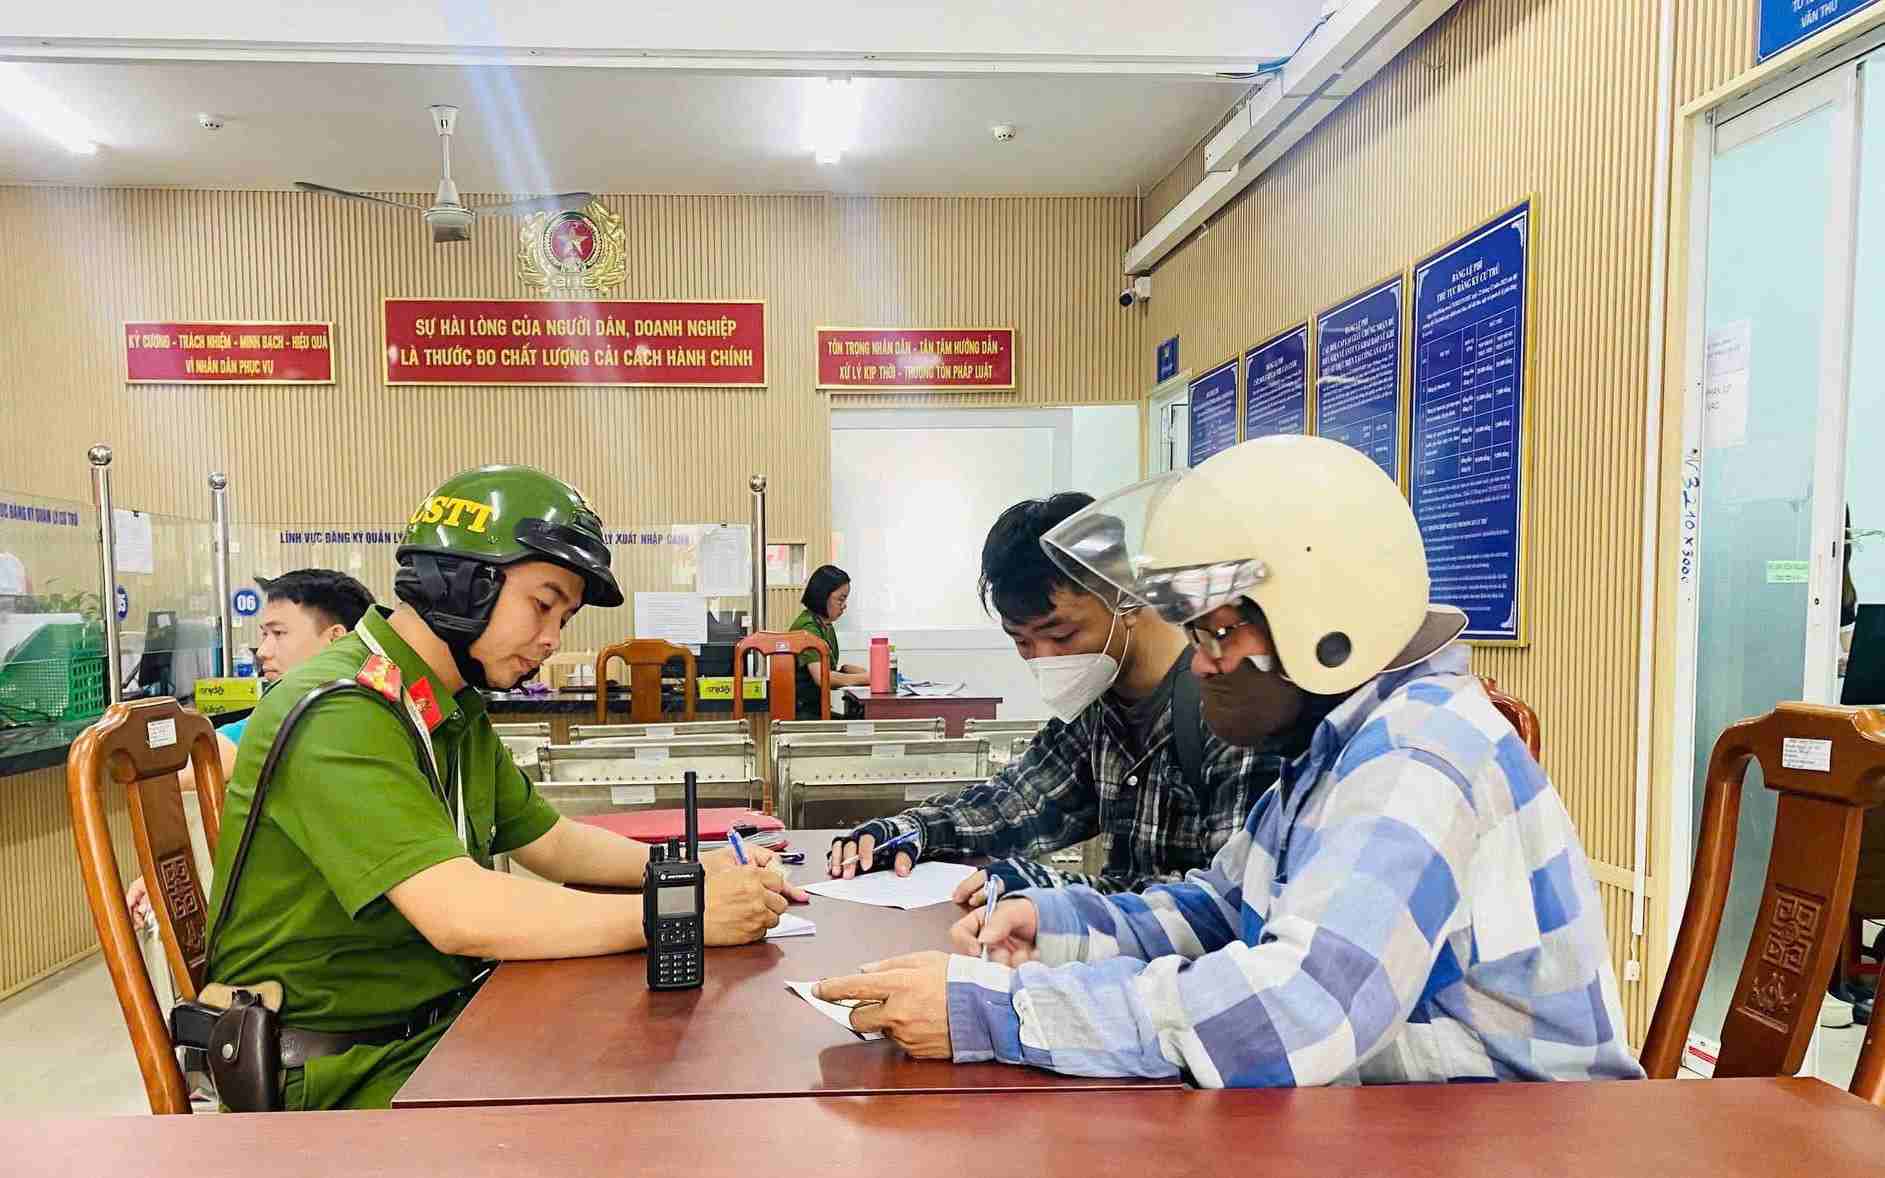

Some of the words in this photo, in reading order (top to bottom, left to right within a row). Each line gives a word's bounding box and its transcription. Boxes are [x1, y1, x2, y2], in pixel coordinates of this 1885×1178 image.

[415, 316, 437, 339] SỰ
[440, 314, 465, 336] HÀI
[471, 314, 507, 336] LÒNG
[511, 314, 540, 336] CỦA
[546, 314, 592, 336] NGƯỜI
[596, 314, 630, 339] DÂN,
[635, 319, 682, 337] DOANH
[687, 314, 737, 340] NGHIỆP
[179, 332, 204, 349] TRÁCH
[206, 332, 231, 351] NHIỆM
[240, 336, 260, 349] MINH
[263, 335, 283, 351] BẠCH
[292, 332, 309, 351] HIỆU
[311, 332, 328, 349] QUẢ
[828, 339, 843, 355] TÔN
[845, 340, 870, 357] TRỌNG
[872, 339, 893, 355] NHÂN
[895, 338, 911, 355] DÂN
[937, 338, 952, 355] TÂM
[954, 337, 980, 355] HƯỚNG
[982, 335, 998, 355] DẪN
[196, 357, 219, 374] NHÂN
[221, 357, 237, 374] DÂN
[239, 359, 260, 376] PHỤC
[400, 345, 418, 367] LÀ
[424, 344, 472, 367] THƯỚC
[476, 349, 497, 367] ĐO
[501, 342, 537, 367] CHẤT
[543, 348, 590, 371] LƯỢNG
[595, 344, 619, 367] CẢI
[624, 344, 662, 367] CÁCH
[667, 345, 706, 367] HÀNH
[710, 344, 752, 367] CHÍNH
[864, 364, 877, 383] KỊP
[879, 362, 896, 379] THỜI
[936, 362, 950, 379] TÔN
[953, 362, 973, 379] PHÁP
[975, 362, 993, 381] LUẬT
[237, 594, 256, 611] 06
